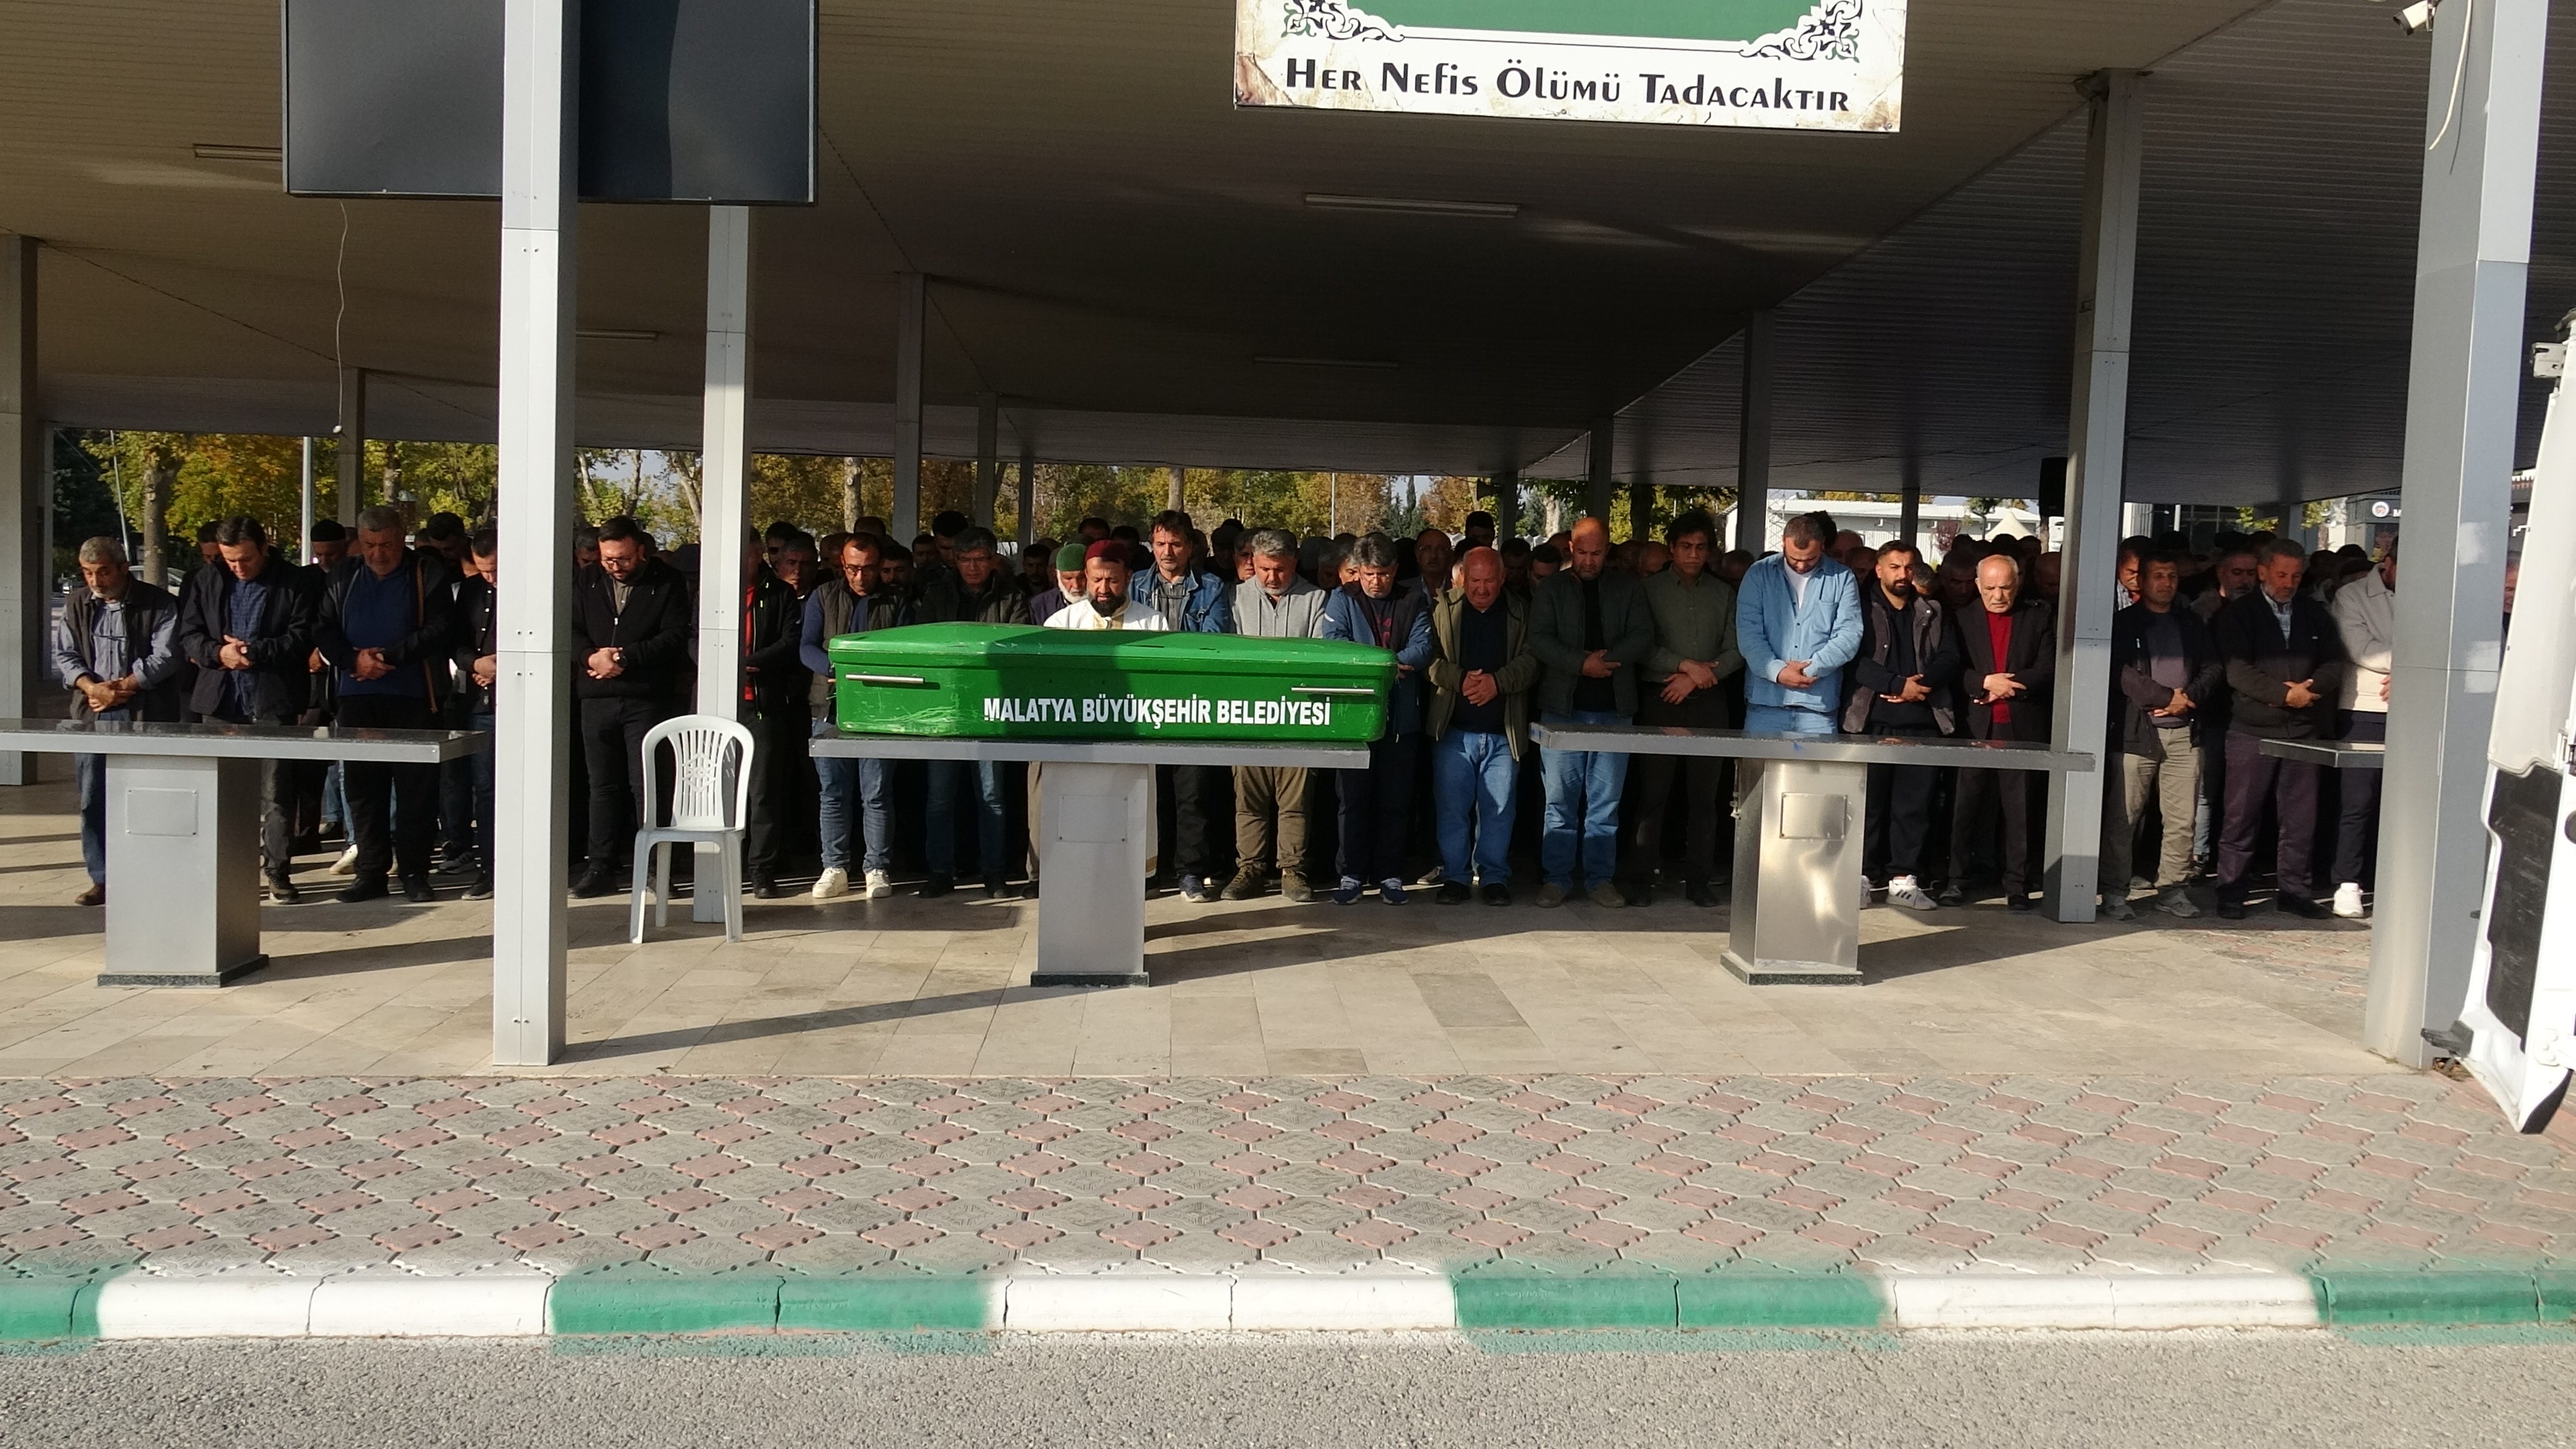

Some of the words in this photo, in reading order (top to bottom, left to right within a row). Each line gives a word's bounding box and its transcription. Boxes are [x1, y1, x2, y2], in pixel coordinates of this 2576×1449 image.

[983, 697, 1076, 722] MALATYA
[1082, 693, 1212, 729] BÜYÜKŞEHİR
[1216, 696, 1332, 726] BELEDİYESİ
